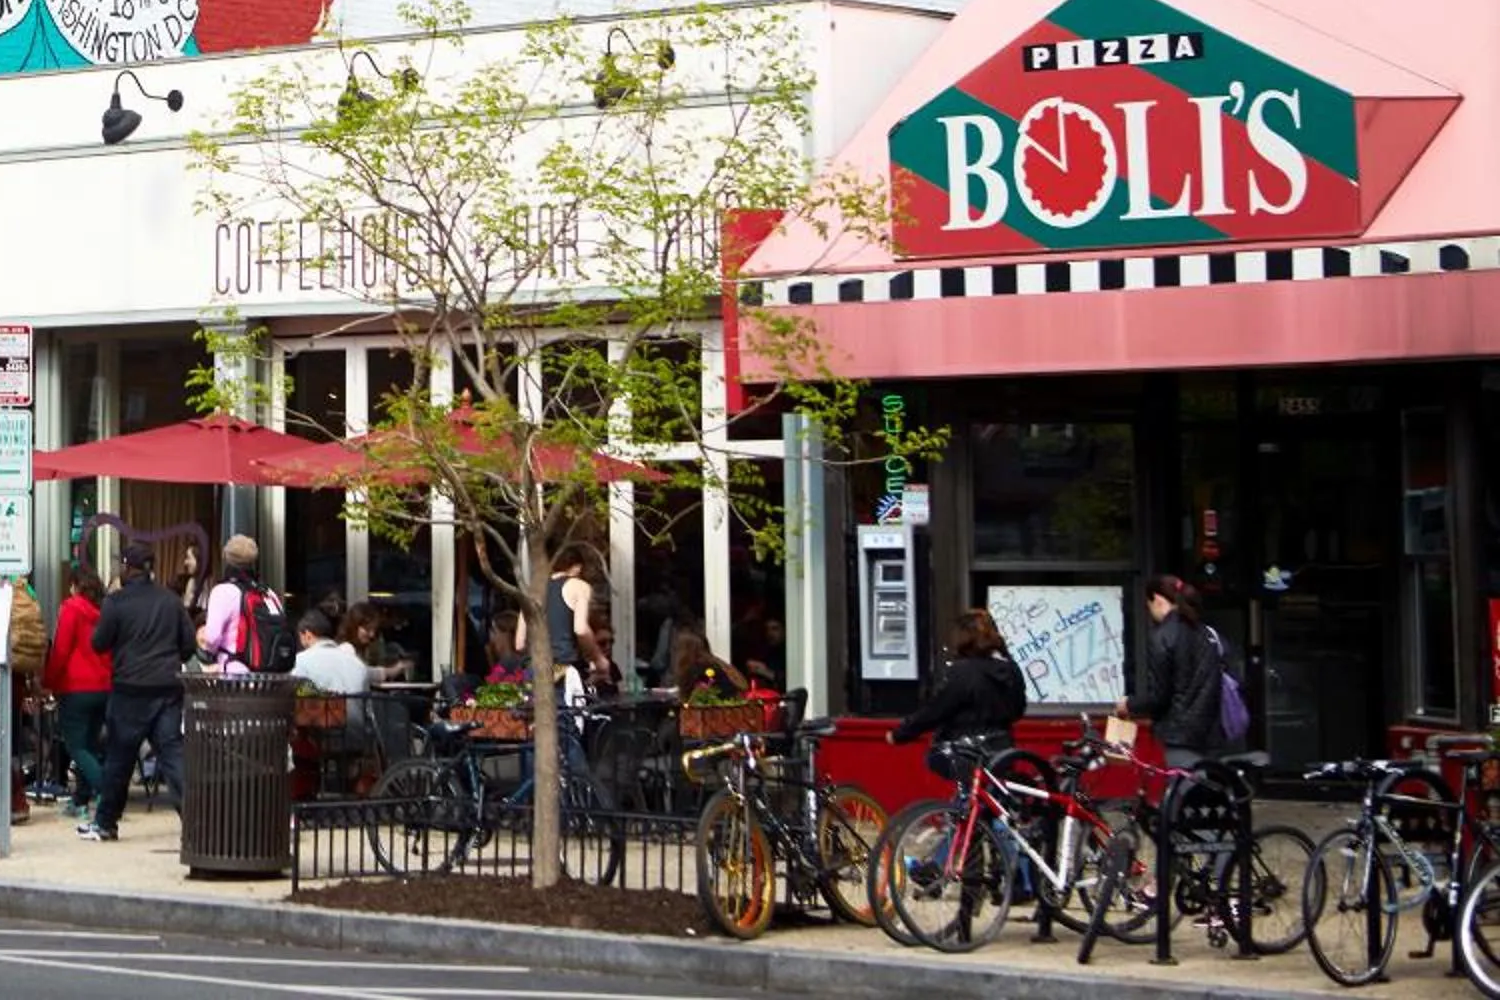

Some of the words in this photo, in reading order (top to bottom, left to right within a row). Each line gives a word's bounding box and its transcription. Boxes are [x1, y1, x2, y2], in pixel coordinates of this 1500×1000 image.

[1030, 34, 1198, 70] PIZZA
[936, 81, 1309, 231] BOLI'S
[1054, 601, 1103, 634] cheese
[1025, 614, 1122, 699] PIZZA
